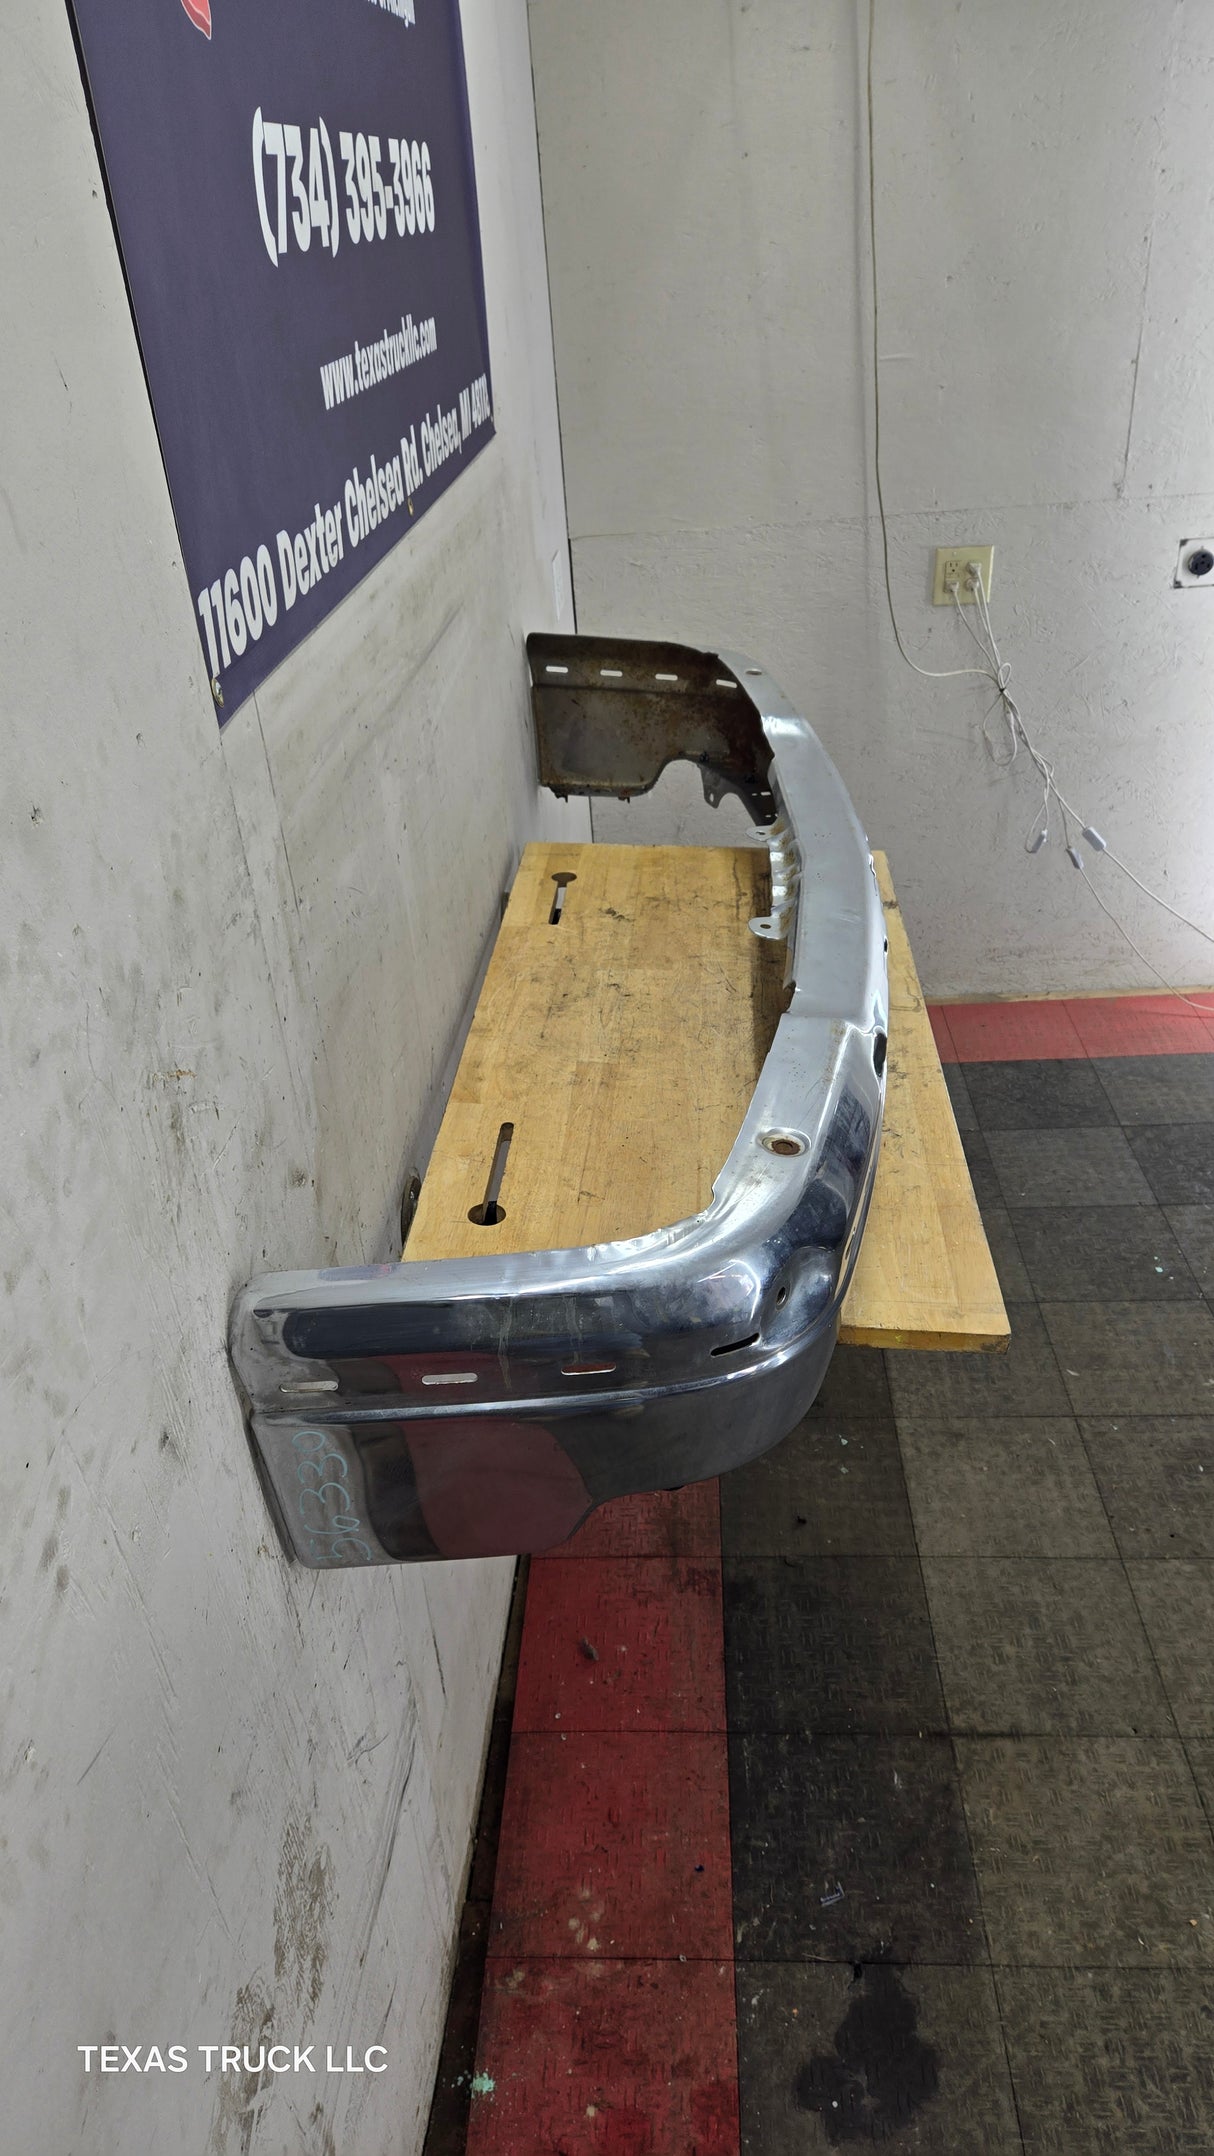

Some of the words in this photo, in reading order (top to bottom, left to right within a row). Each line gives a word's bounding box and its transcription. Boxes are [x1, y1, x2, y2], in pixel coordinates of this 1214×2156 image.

[252, 106, 338, 267] (734)
[339, 131, 435, 244] 395-3966
[320, 313, 437, 410] www.texastruckllc.com
[197, 544, 277, 678] 11600
[276, 503, 344, 611] Dexter
[344, 454, 404, 547] Chelsea
[400, 424, 423, 497] Rd.
[421, 404, 462, 478] Chelsea,
[459, 387, 471, 440] MI
[292, 1431, 372, 1561] 56330
